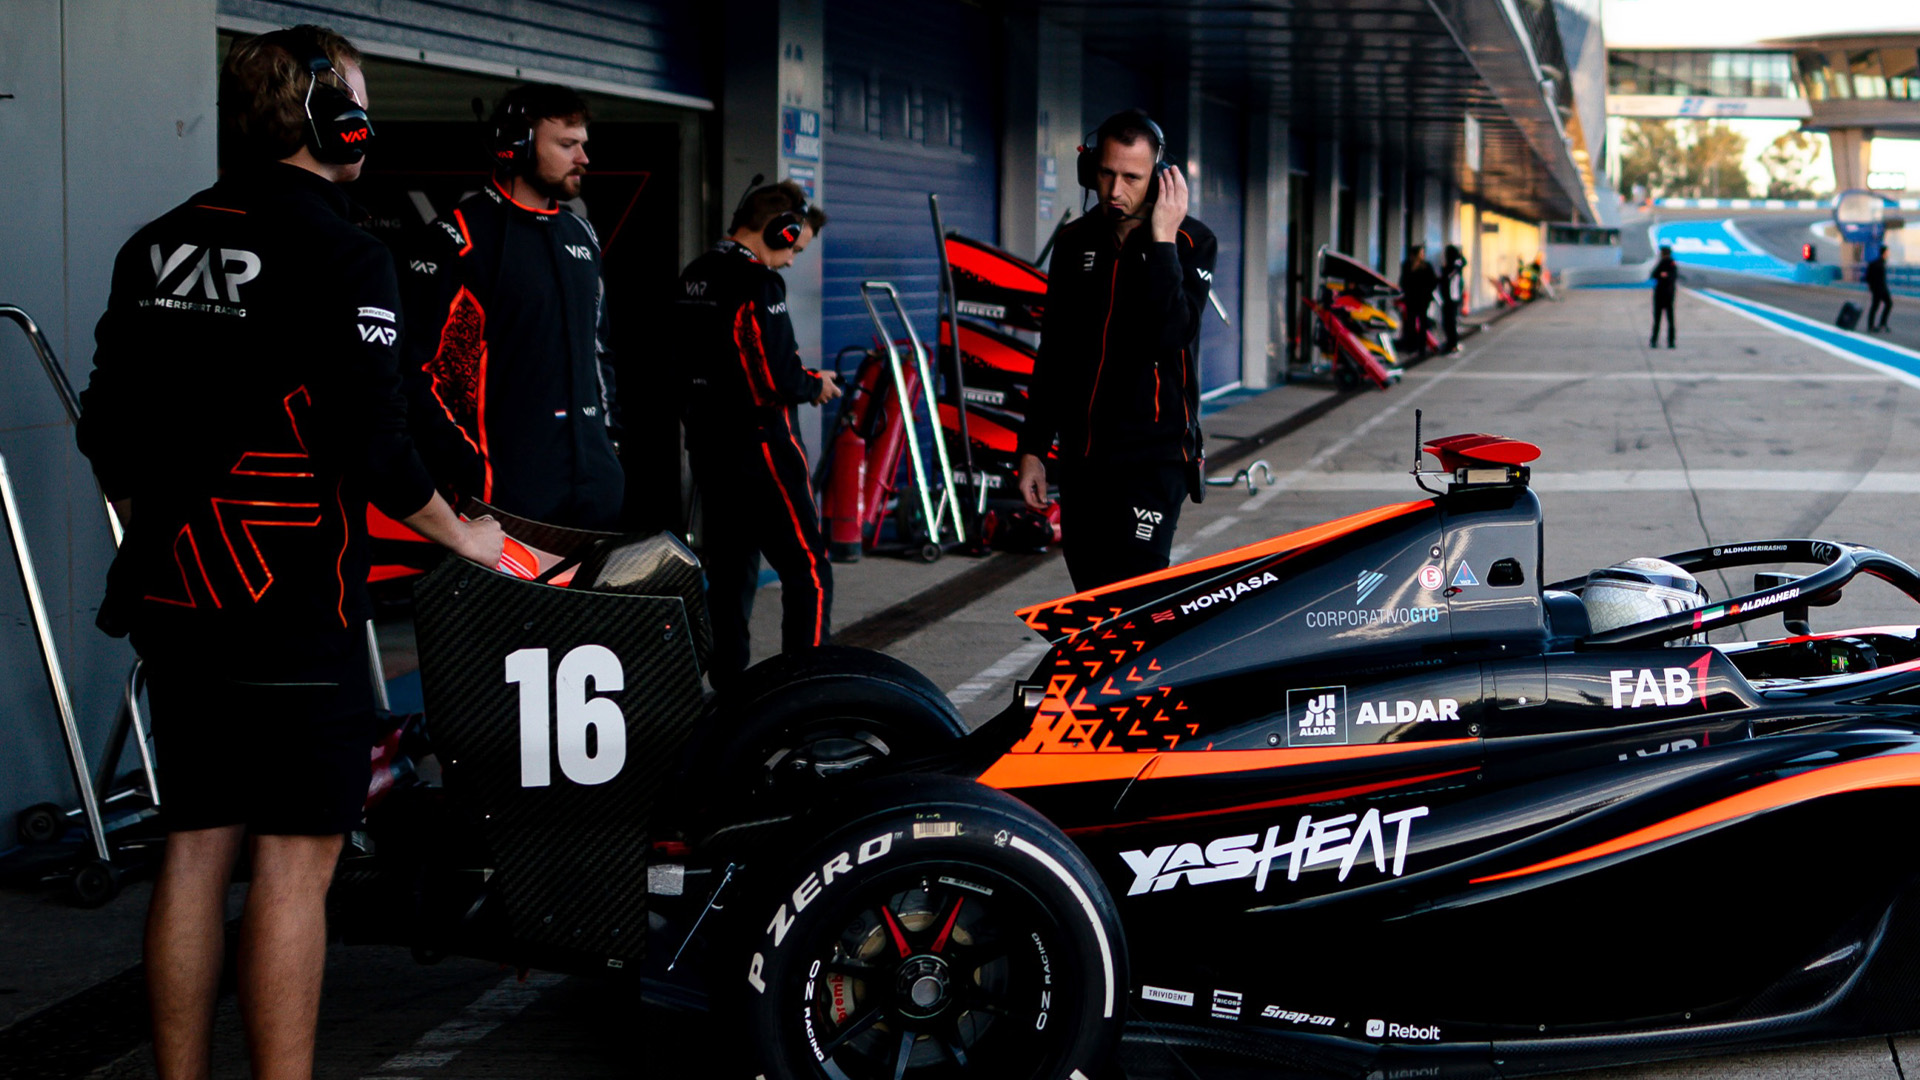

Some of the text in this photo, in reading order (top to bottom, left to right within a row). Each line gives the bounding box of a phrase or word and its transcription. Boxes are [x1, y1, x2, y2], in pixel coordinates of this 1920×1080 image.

[340, 127, 368, 143] VAR
[564, 244, 593, 261] VAR
[150, 243, 262, 303] VAR
[409, 259, 438, 275] VAR
[1196, 267, 1212, 283] VA
[685, 280, 707, 296] VAR
[155, 297, 212, 312] MERSFRT
[357, 323, 397, 346] VAR
[962, 387, 1004, 405] IRELLI
[1132, 506, 1164, 525] VAR
[1180, 571, 1279, 615] MONJASA
[504, 643, 627, 788] 16
[1356, 699, 1460, 725] ALDAR
[1299, 726, 1336, 737] ALDAR
[1031, 932, 1051, 985] RACING
[748, 951, 767, 994] P
[831, 972, 848, 1024] bremb
[1148, 989, 1187, 1002] TRIVIDENT
[1261, 1005, 1335, 1027] Snap-on
[804, 1006, 825, 1062] RACING
[1388, 1023, 1441, 1041] Rebolt
